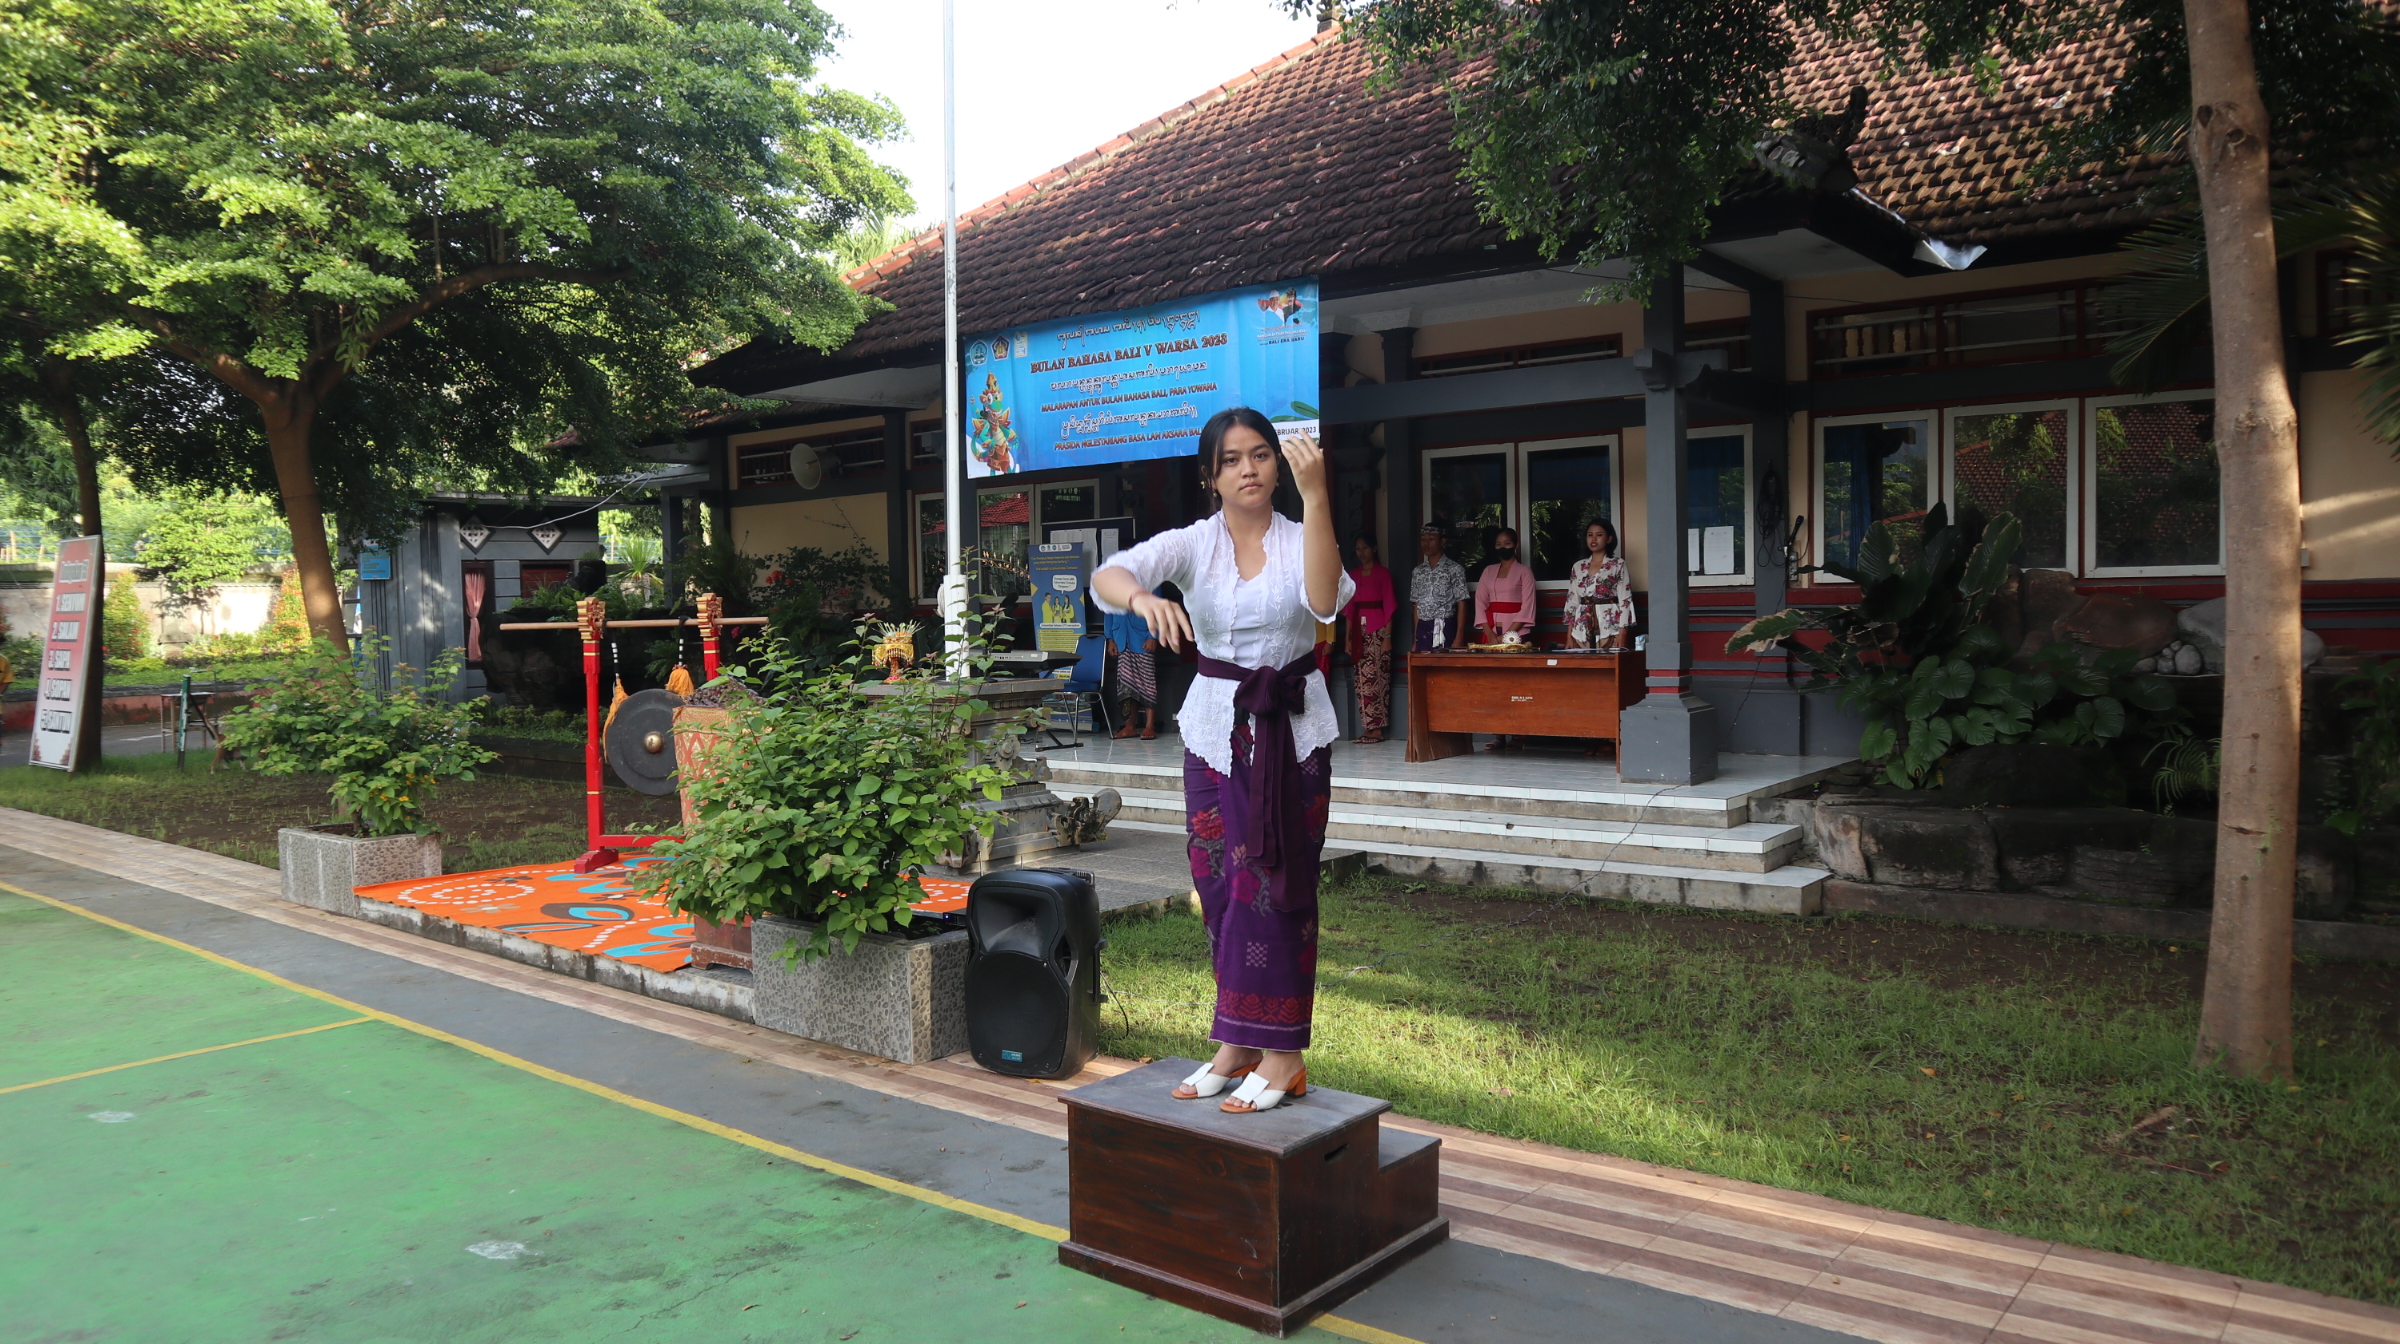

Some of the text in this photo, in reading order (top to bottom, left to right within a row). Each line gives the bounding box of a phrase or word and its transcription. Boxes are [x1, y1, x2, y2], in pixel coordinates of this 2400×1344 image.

[1030, 333, 1228, 374] BULAN BAHASA BALI V WARSA 2023
[1041, 382, 1218, 412] MALARAPAN ANTUK BULAN BAHASA BALI, PARA YOWANA
[1054, 441, 1080, 451] PRASIDA
[1128, 433, 1146, 443] BASA
[1146, 431, 1161, 441] LAN
[1161, 428, 1188, 439] AKSARA
